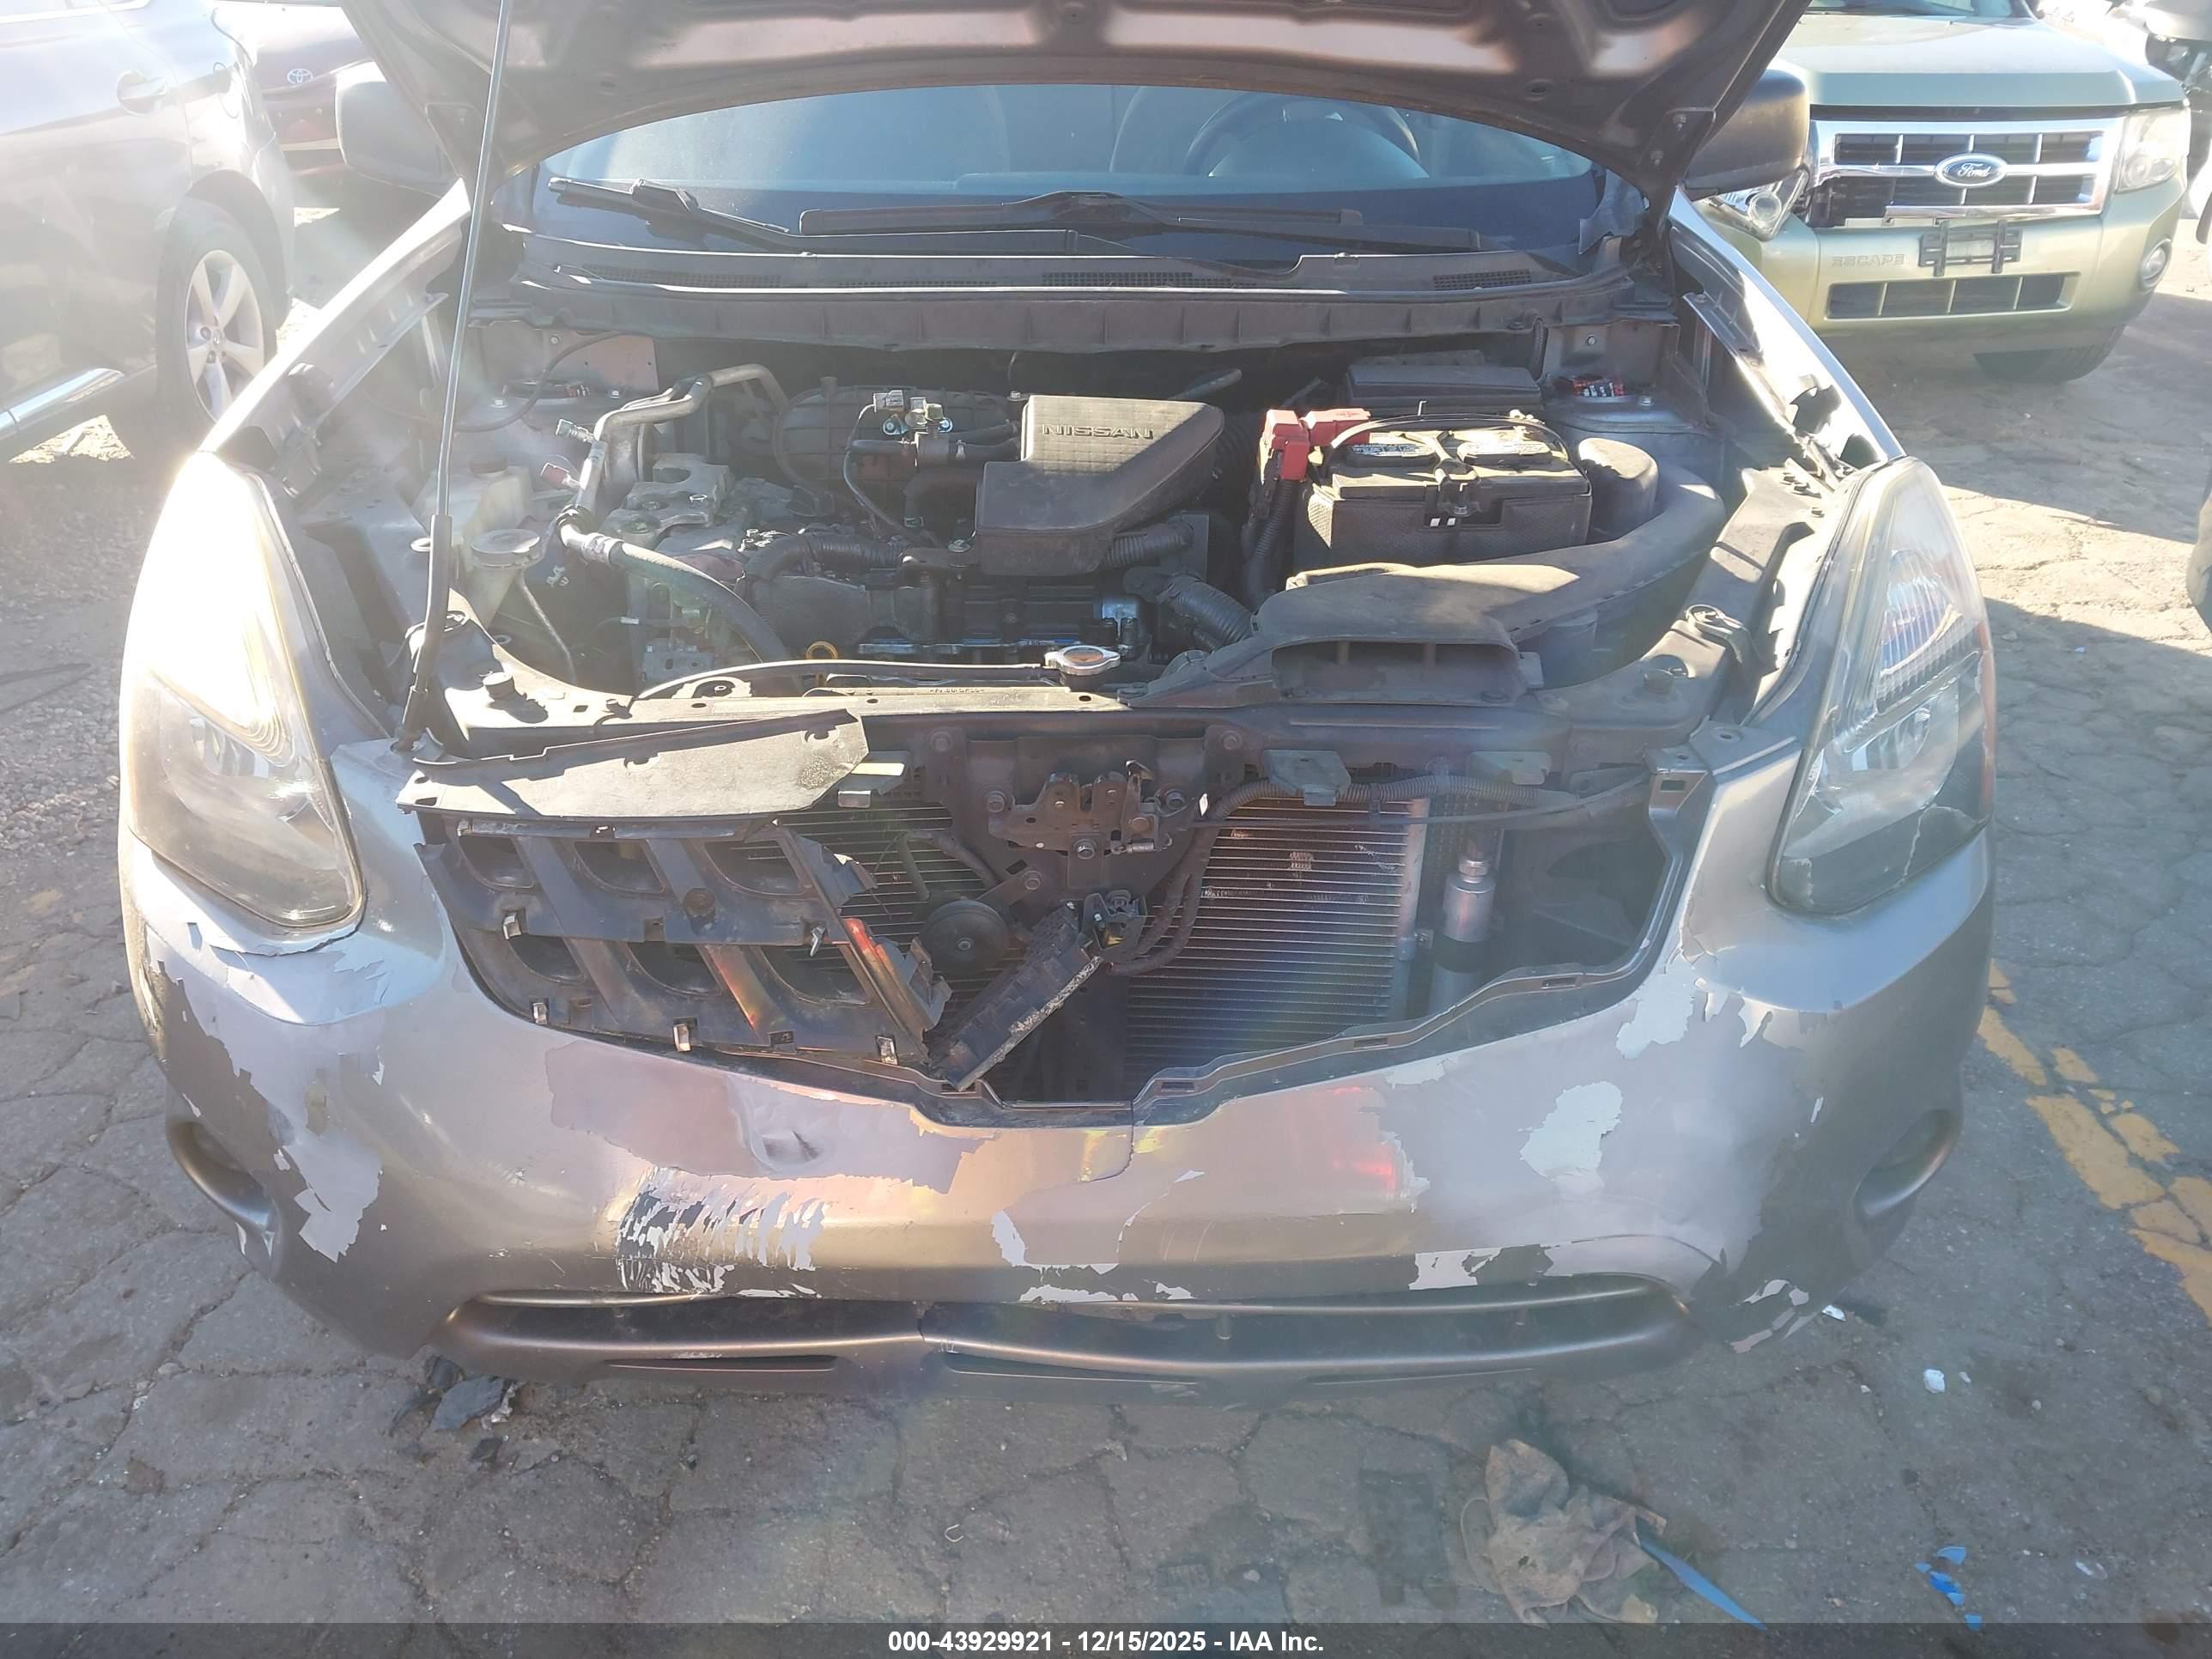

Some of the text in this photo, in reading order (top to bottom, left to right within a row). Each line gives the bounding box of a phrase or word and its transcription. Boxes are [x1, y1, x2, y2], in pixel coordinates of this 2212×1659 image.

[1957, 162, 1992, 178] Ford
[1832, 253, 1905, 267] ESCAPE
[1042, 423, 1154, 440] NISSAN
